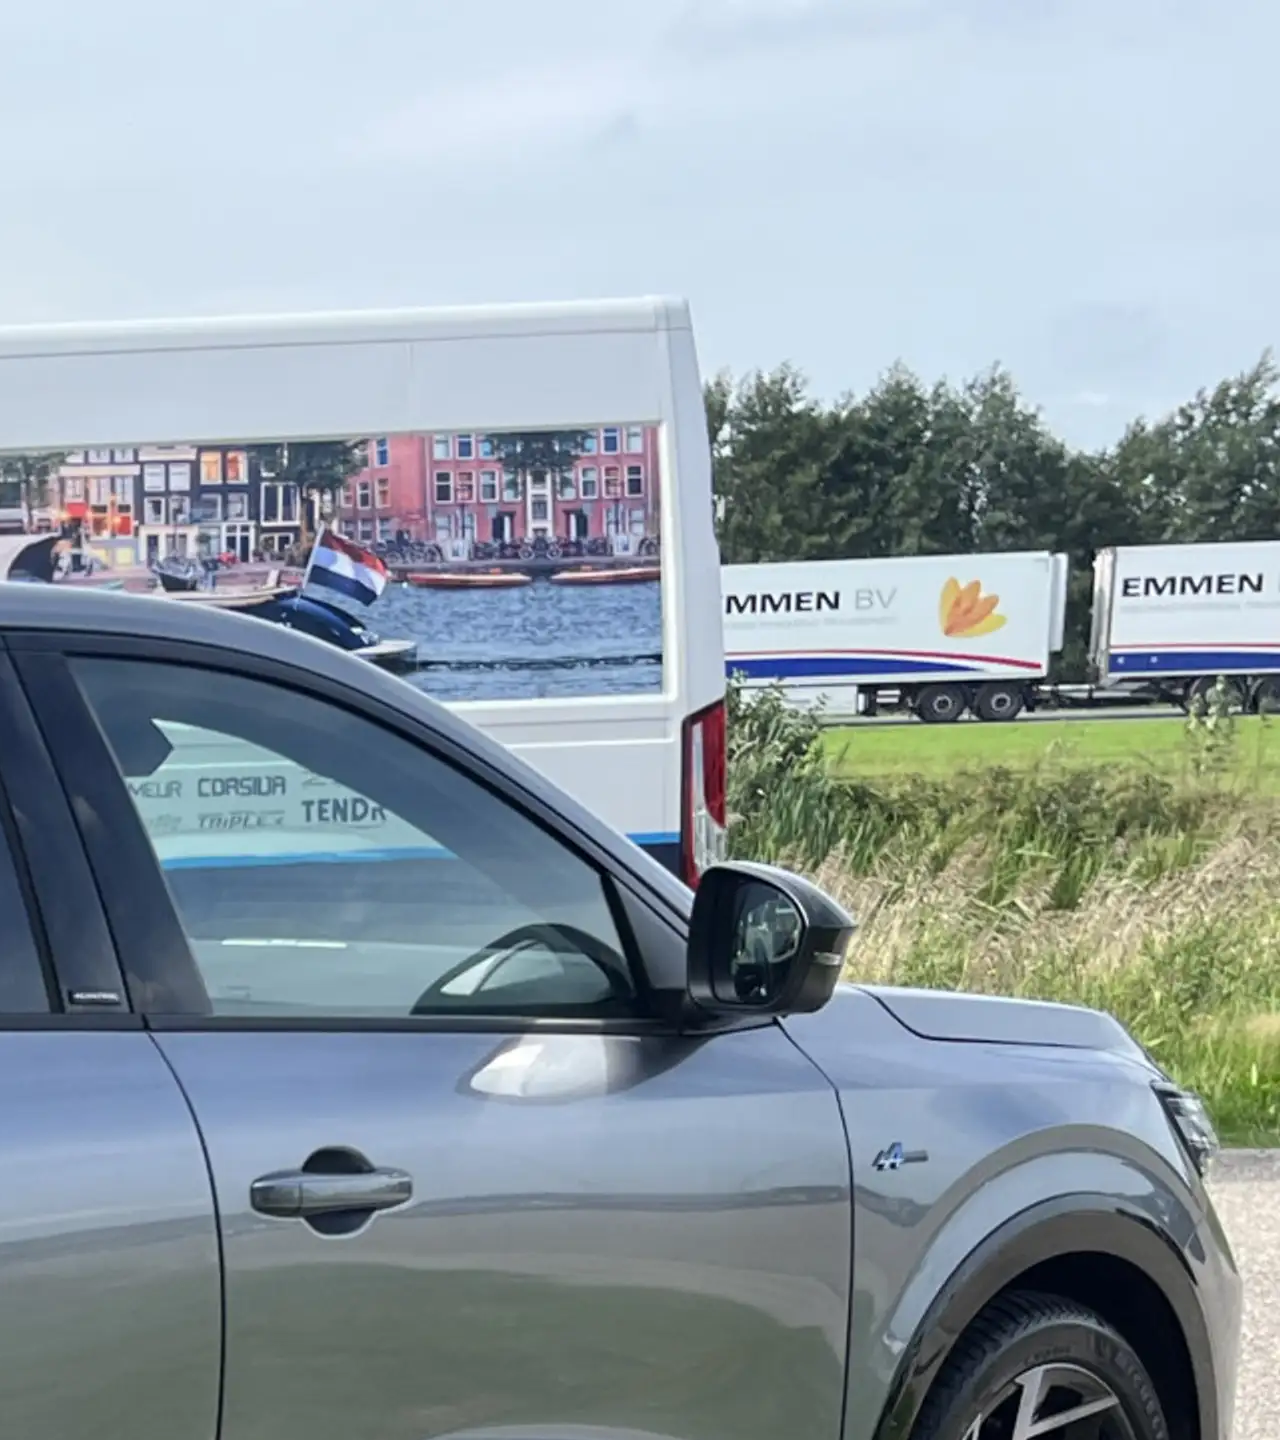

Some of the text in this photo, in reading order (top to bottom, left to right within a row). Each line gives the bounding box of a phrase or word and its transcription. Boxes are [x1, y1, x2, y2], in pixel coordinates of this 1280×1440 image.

[1122, 573, 1264, 597] EMMEN
[720, 587, 897, 614] MMEN BV
